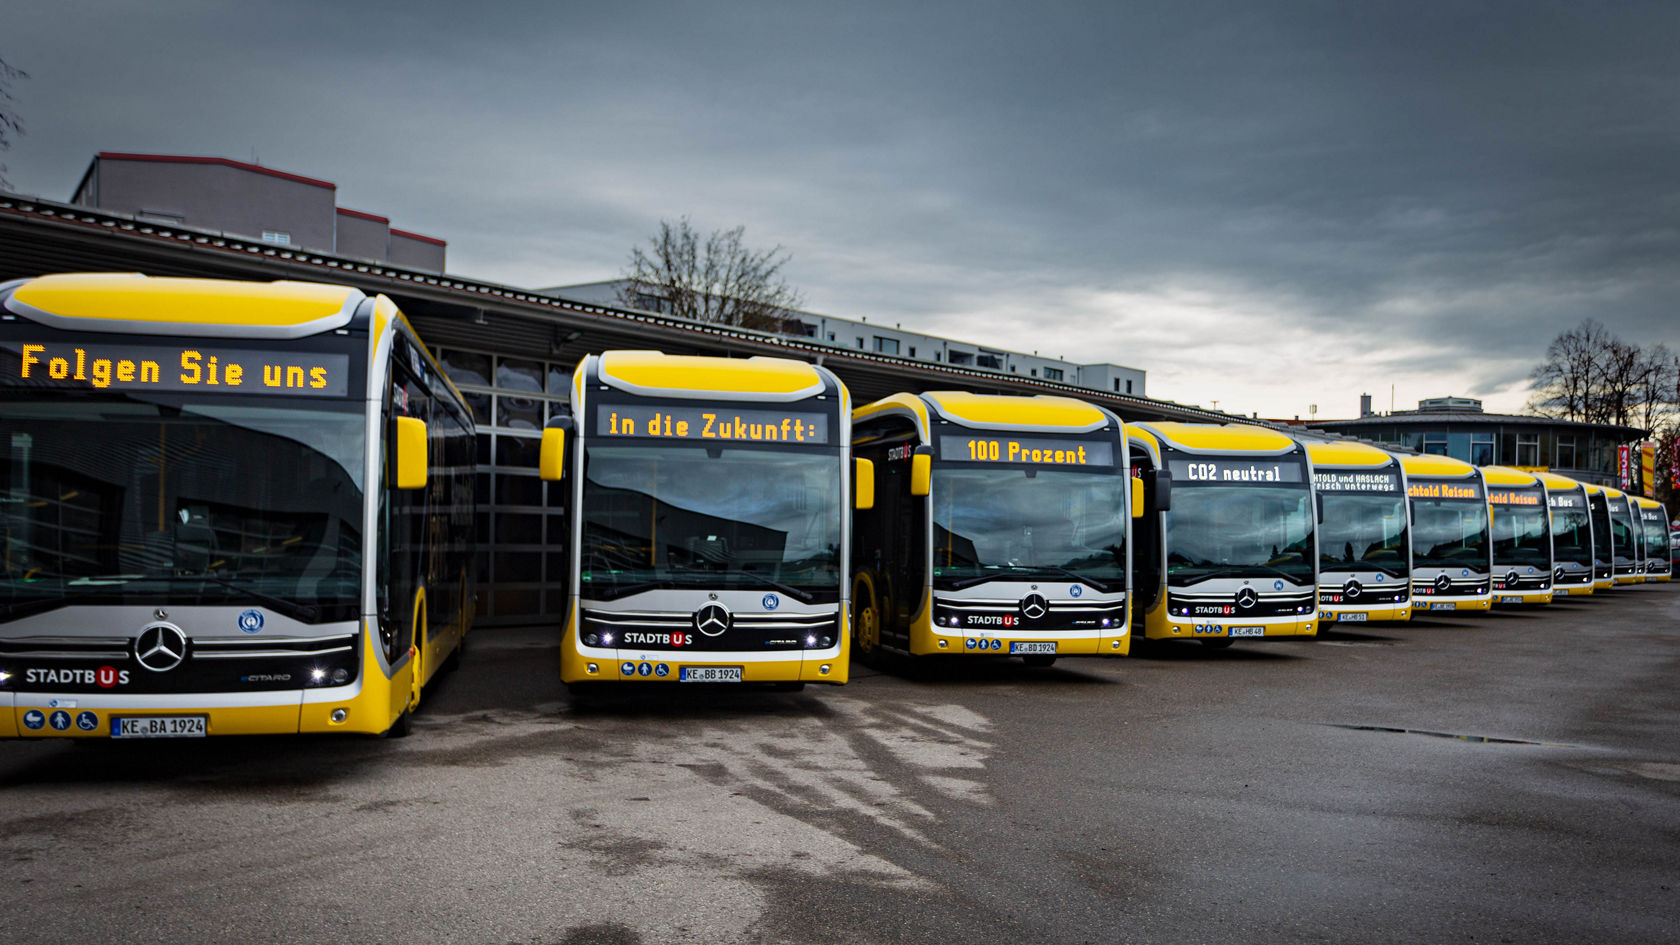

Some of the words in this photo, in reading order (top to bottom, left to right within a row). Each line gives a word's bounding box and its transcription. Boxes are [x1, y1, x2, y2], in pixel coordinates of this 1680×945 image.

[21, 343, 160, 388] Folgen
[181, 350, 243, 386] Sie
[263, 365, 328, 389] uns
[609, 412, 635, 435] in
[648, 413, 689, 437] die
[701, 413, 815, 442] Zukunft:
[967, 439, 1000, 461] 100
[1008, 441, 1086, 465] Prozent
[1188, 463, 1217, 481] CO2
[1223, 465, 1281, 482] neutral
[1338, 474, 1354, 484] und
[1355, 474, 1390, 484] HASLACH
[1314, 482, 1341, 491] risch
[1344, 482, 1395, 492] unterwegs
[1441, 484, 1475, 498] Reisen
[1558, 496, 1573, 507] Bus
[1195, 605, 1236, 615] STADTBUS
[967, 615, 1020, 626] STADTBUS
[624, 632, 693, 645] STADTBUS
[1015, 643, 1024, 652] KE
[1039, 643, 1055, 652] 1924
[25, 668, 130, 685] STADTBUS
[686, 669, 699, 680] KE
[704, 669, 716, 680] BB
[718, 669, 740, 679] 1924
[121, 719, 140, 734] KE
[150, 719, 168, 734] BA
[170, 718, 204, 734] 1924
